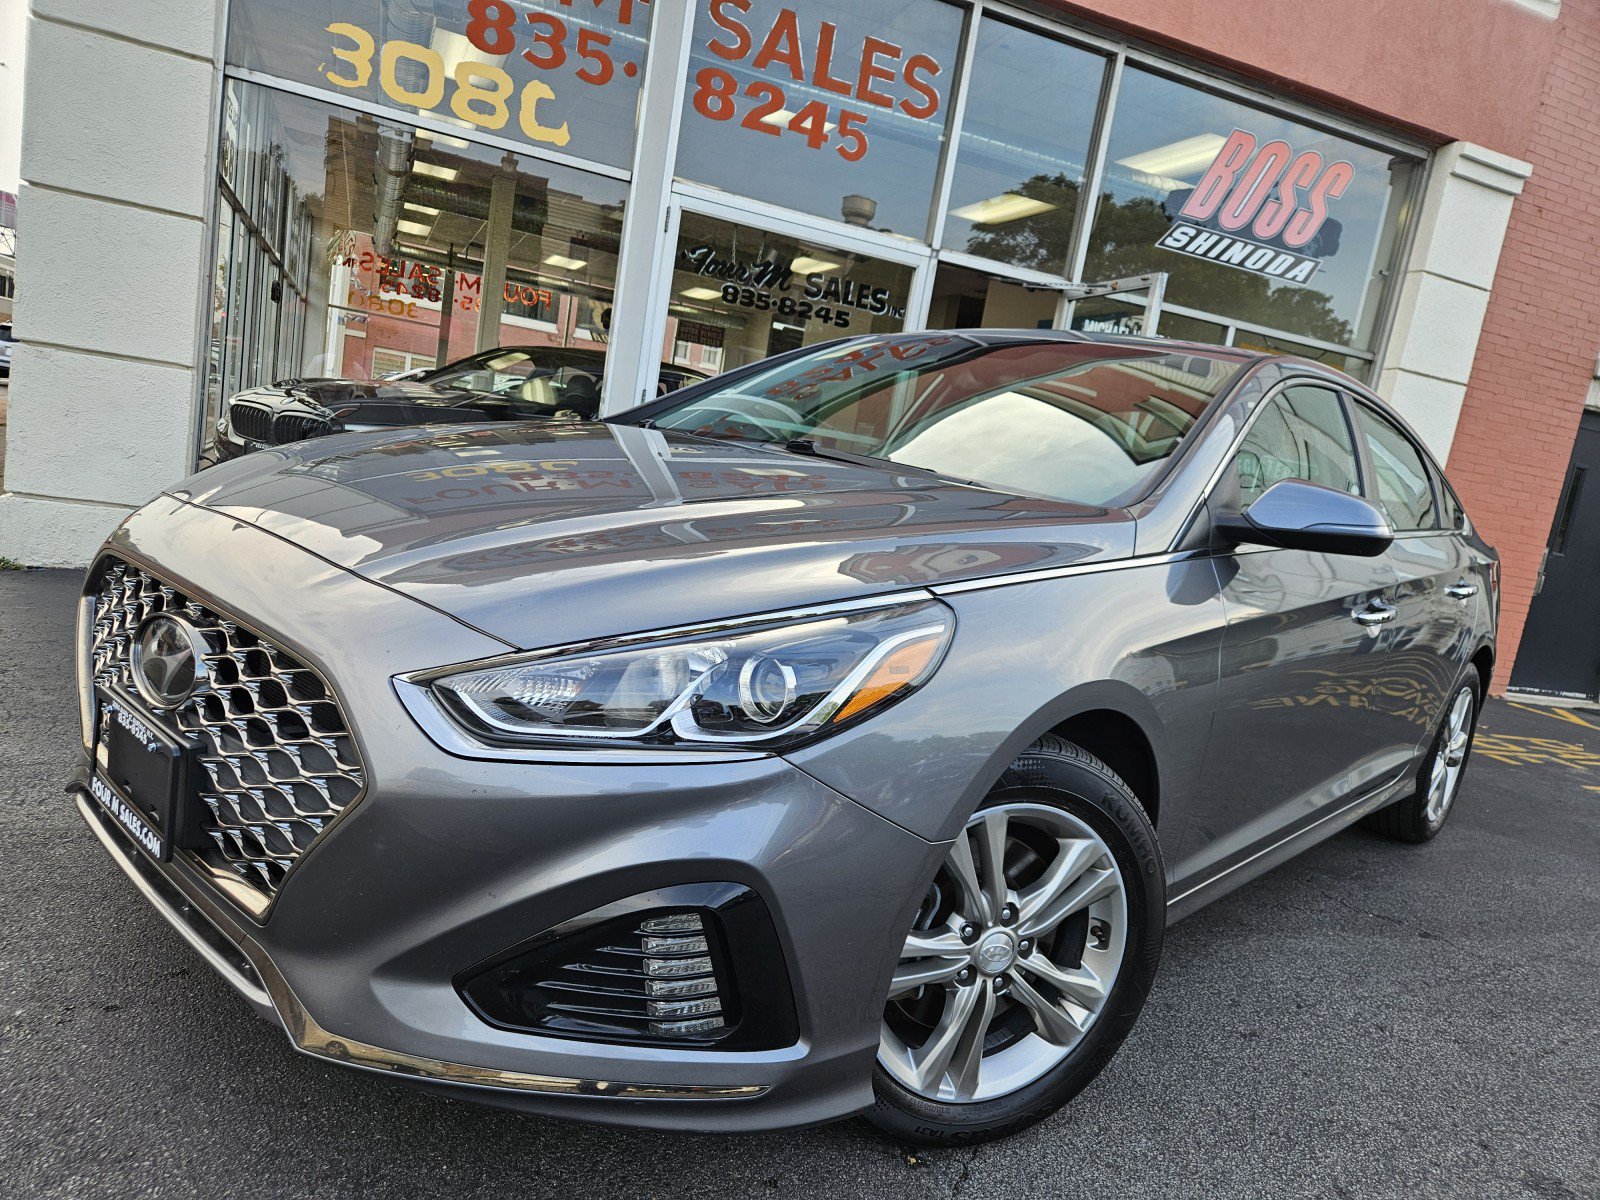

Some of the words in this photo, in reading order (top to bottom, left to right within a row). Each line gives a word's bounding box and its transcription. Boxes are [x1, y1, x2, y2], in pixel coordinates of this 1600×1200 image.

[706, 0, 942, 119] SALES
[693, 68, 868, 162] 8245
[1180, 128, 1355, 248] BOSS
[751, 259, 793, 292] M
[803, 271, 890, 316] SALES
[1163, 226, 1319, 283] SHINODA
[91, 776, 112, 808] FOUR
[110, 795, 120, 816] M
[119, 804, 161, 859] SALES.COM
